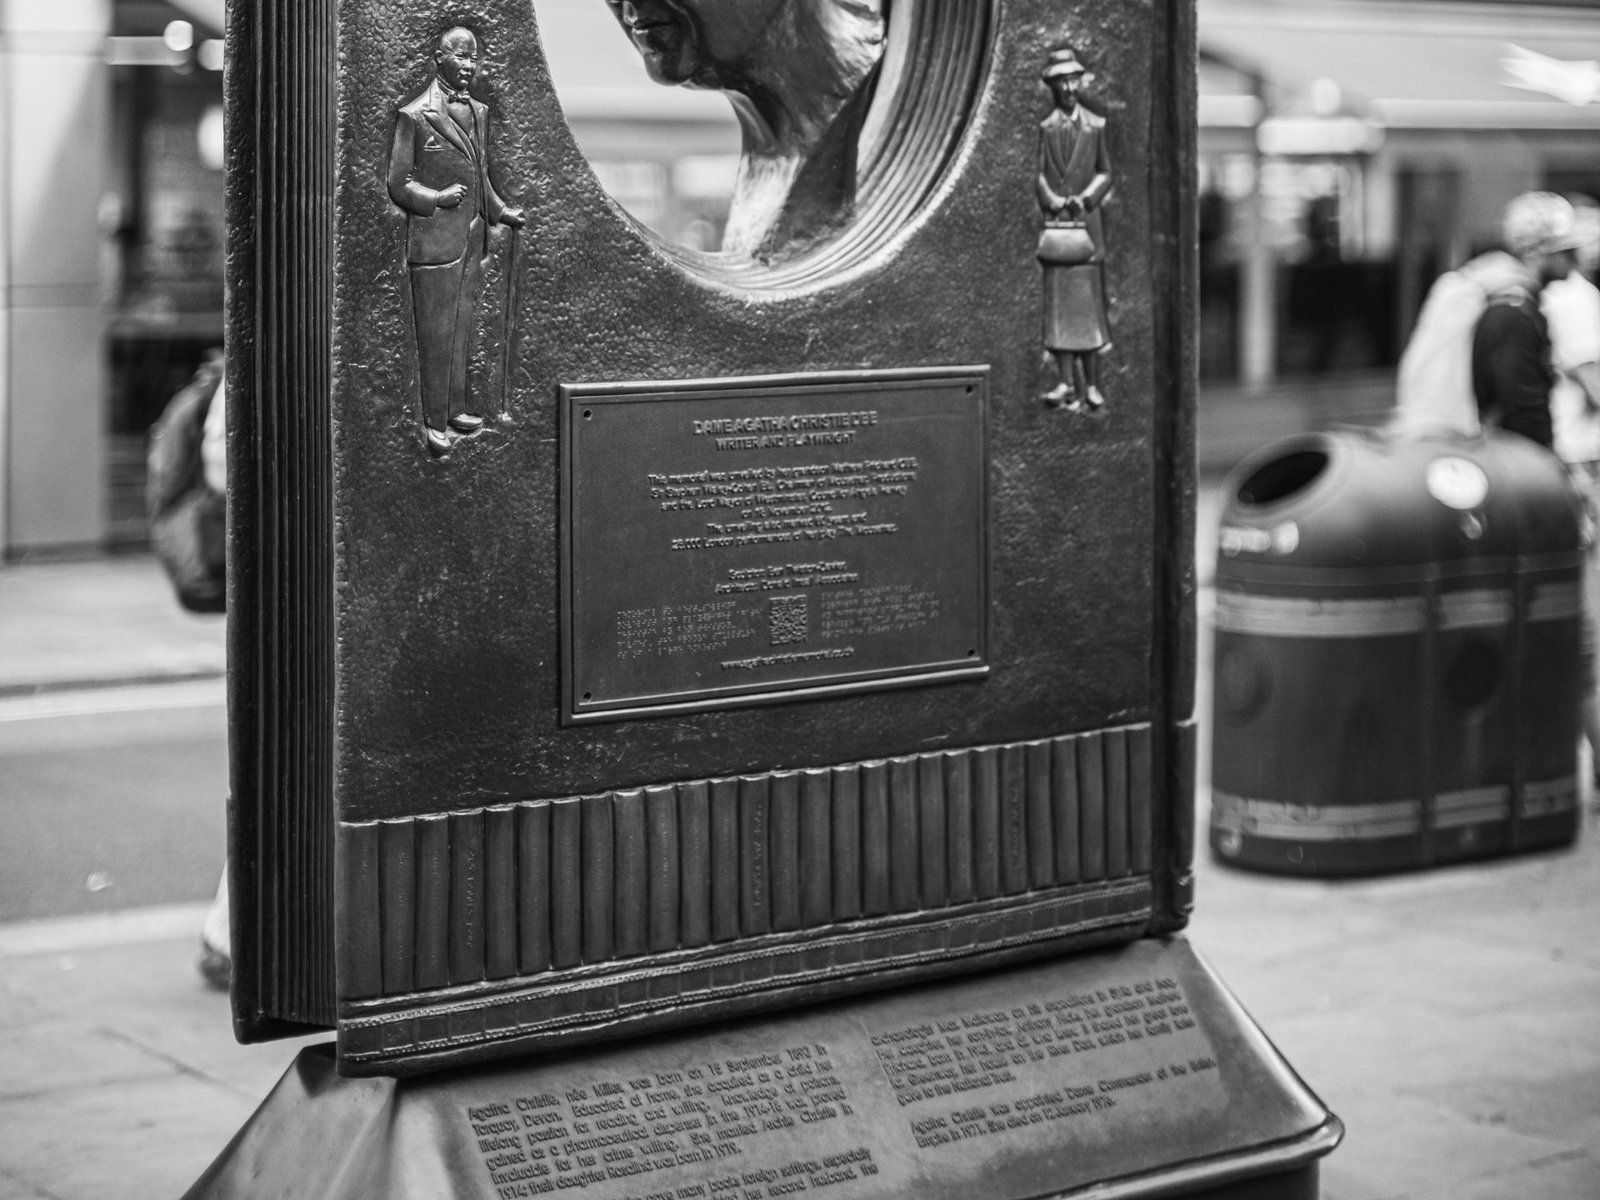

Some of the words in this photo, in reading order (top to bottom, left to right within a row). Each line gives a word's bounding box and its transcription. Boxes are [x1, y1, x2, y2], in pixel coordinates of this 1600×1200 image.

[693, 418, 730, 436] DAME
[732, 415, 787, 434] AGATHA
[788, 411, 848, 430] CHRISTIE
[714, 435, 759, 451] WRITER
[759, 434, 784, 448] AND
[785, 429, 856, 447] PLAYWRIGHT
[467, 1101, 512, 1122] Agatha
[516, 1092, 560, 1111] Christie,
[565, 1087, 587, 1101] née
[593, 1080, 624, 1097] Miller,
[630, 1078, 651, 1089] was
[656, 1070, 683, 1084] born
[689, 1069, 702, 1079] on
[726, 1052, 783, 1075] September
[787, 1047, 811, 1061] 1890
[816, 1044, 827, 1055] in
[473, 1117, 520, 1138] Torquay,
[523, 1109, 562, 1125] Devon.
[572, 1097, 626, 1116] Educated
[629, 1094, 642, 1106] at
[646, 1087, 680, 1103] home,
[683, 1083, 703, 1096] she
[707, 1074, 755, 1094] acquired
[758, 1073, 770, 1082] as
[775, 1071, 783, 1079] a
[786, 1063, 812, 1076] child
[815, 1059, 833, 1071] her
[479, 1134, 522, 1154] lifelong
[526, 1125, 569, 1145] passion
[574, 1121, 590, 1133] for
[595, 1112, 638, 1132] reading
[643, 1107, 666, 1120] and
[672, 1099, 711, 1117] writing.
[721, 1086, 779, 1108] Knowledge
[784, 1083, 795, 1094] of
[485, 1149, 527, 1169] gained
[531, 1148, 545, 1158] as
[550, 1146, 560, 1154] a
[562, 1127, 650, 1154] pharmaceutical
[652, 1117, 702, 1137] dispenser
[706, 1114, 717, 1124] in
[721, 1109, 740, 1121] the
[811, 1090, 847, 1106] proved
[909, 1115, 948, 1134] Agatha
[950, 1107, 986, 1122] Christie
[990, 1104, 1010, 1114] was
[1013, 1091, 1064, 1111] appointed
[916, 1131, 951, 1149] Empire
[1006, 1114, 1029, 1127] died
[491, 1162, 550, 1183] invaluable
[555, 1158, 571, 1170] for
[577, 1153, 596, 1166] her
[602, 1146, 635, 1161] crime
[639, 1137, 680, 1156] writing.
[690, 1131, 711, 1144] She
[716, 1122, 757, 1138] married
[760, 1115, 795, 1130] Archie
[799, 1106, 837, 1122] Christie
[842, 1103, 853, 1114] in
[528, 1178, 555, 1193] their
[555, 1168, 607, 1190] daughter
[607, 1159, 654, 1177] Rosalind
[654, 1157, 675, 1168] was
[675, 1150, 702, 1164] born
[701, 1147, 713, 1159] in
[714, 1142, 741, 1156] 1919.
[676, 1185, 705, 1200] many
[708, 1174, 740, 1190] books
[741, 1166, 779, 1186] foreign
[822, 1147, 872, 1168] especially
[744, 1186, 761, 1200] her
[767, 1178, 805, 1194] second
[810, 1167, 857, 1186] husband,
[860, 1163, 878, 1174] the
